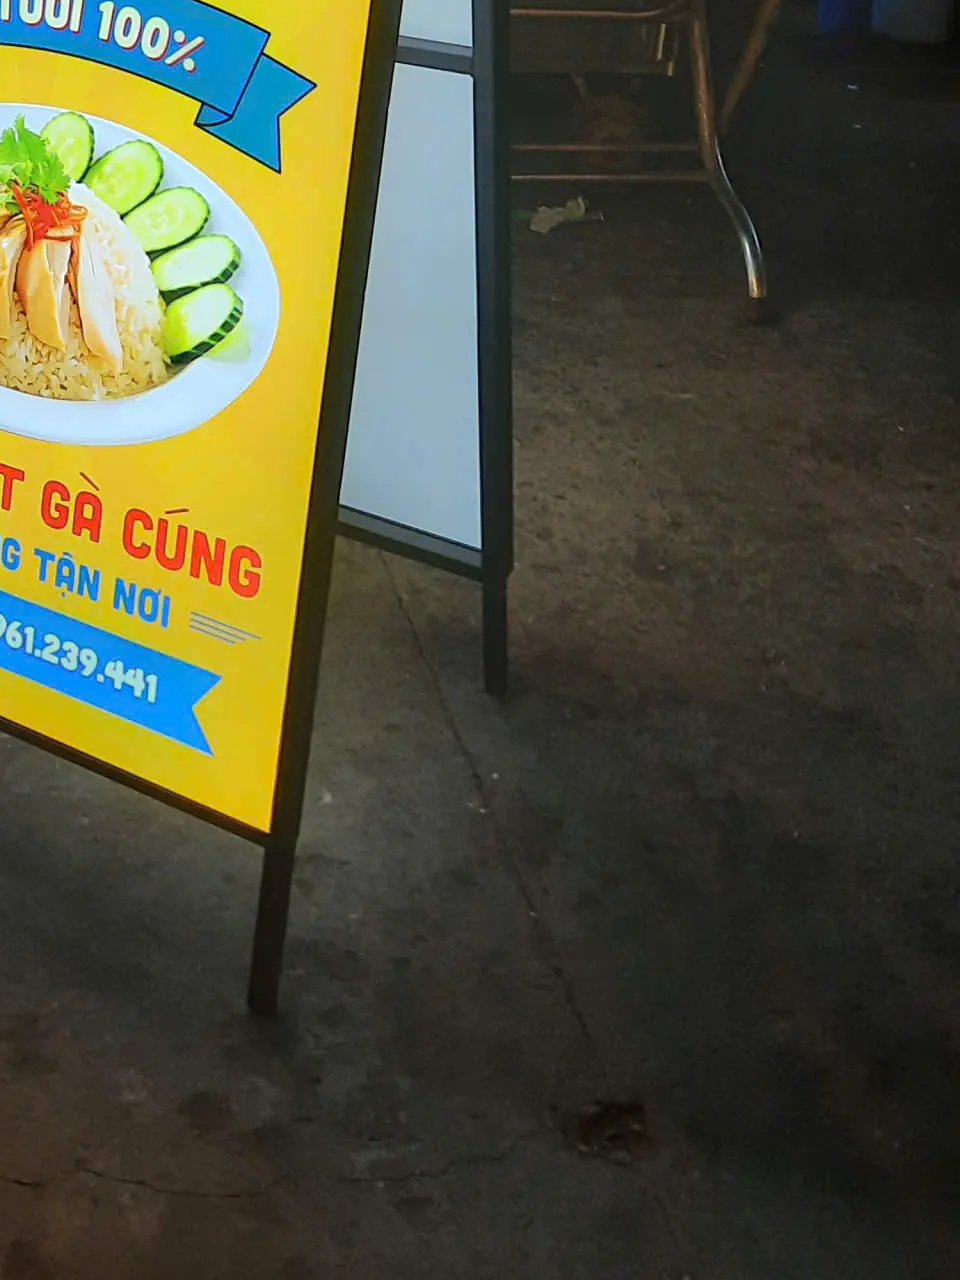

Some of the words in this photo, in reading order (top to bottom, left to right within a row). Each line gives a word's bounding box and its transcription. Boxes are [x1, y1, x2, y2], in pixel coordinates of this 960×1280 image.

[97, 0, 206, 74] 100%
[40, 471, 103, 544] GÀ
[122, 508, 263, 599] CÚNG
[33, 547, 101, 599] TẬN
[112, 577, 172, 630] NƠI
